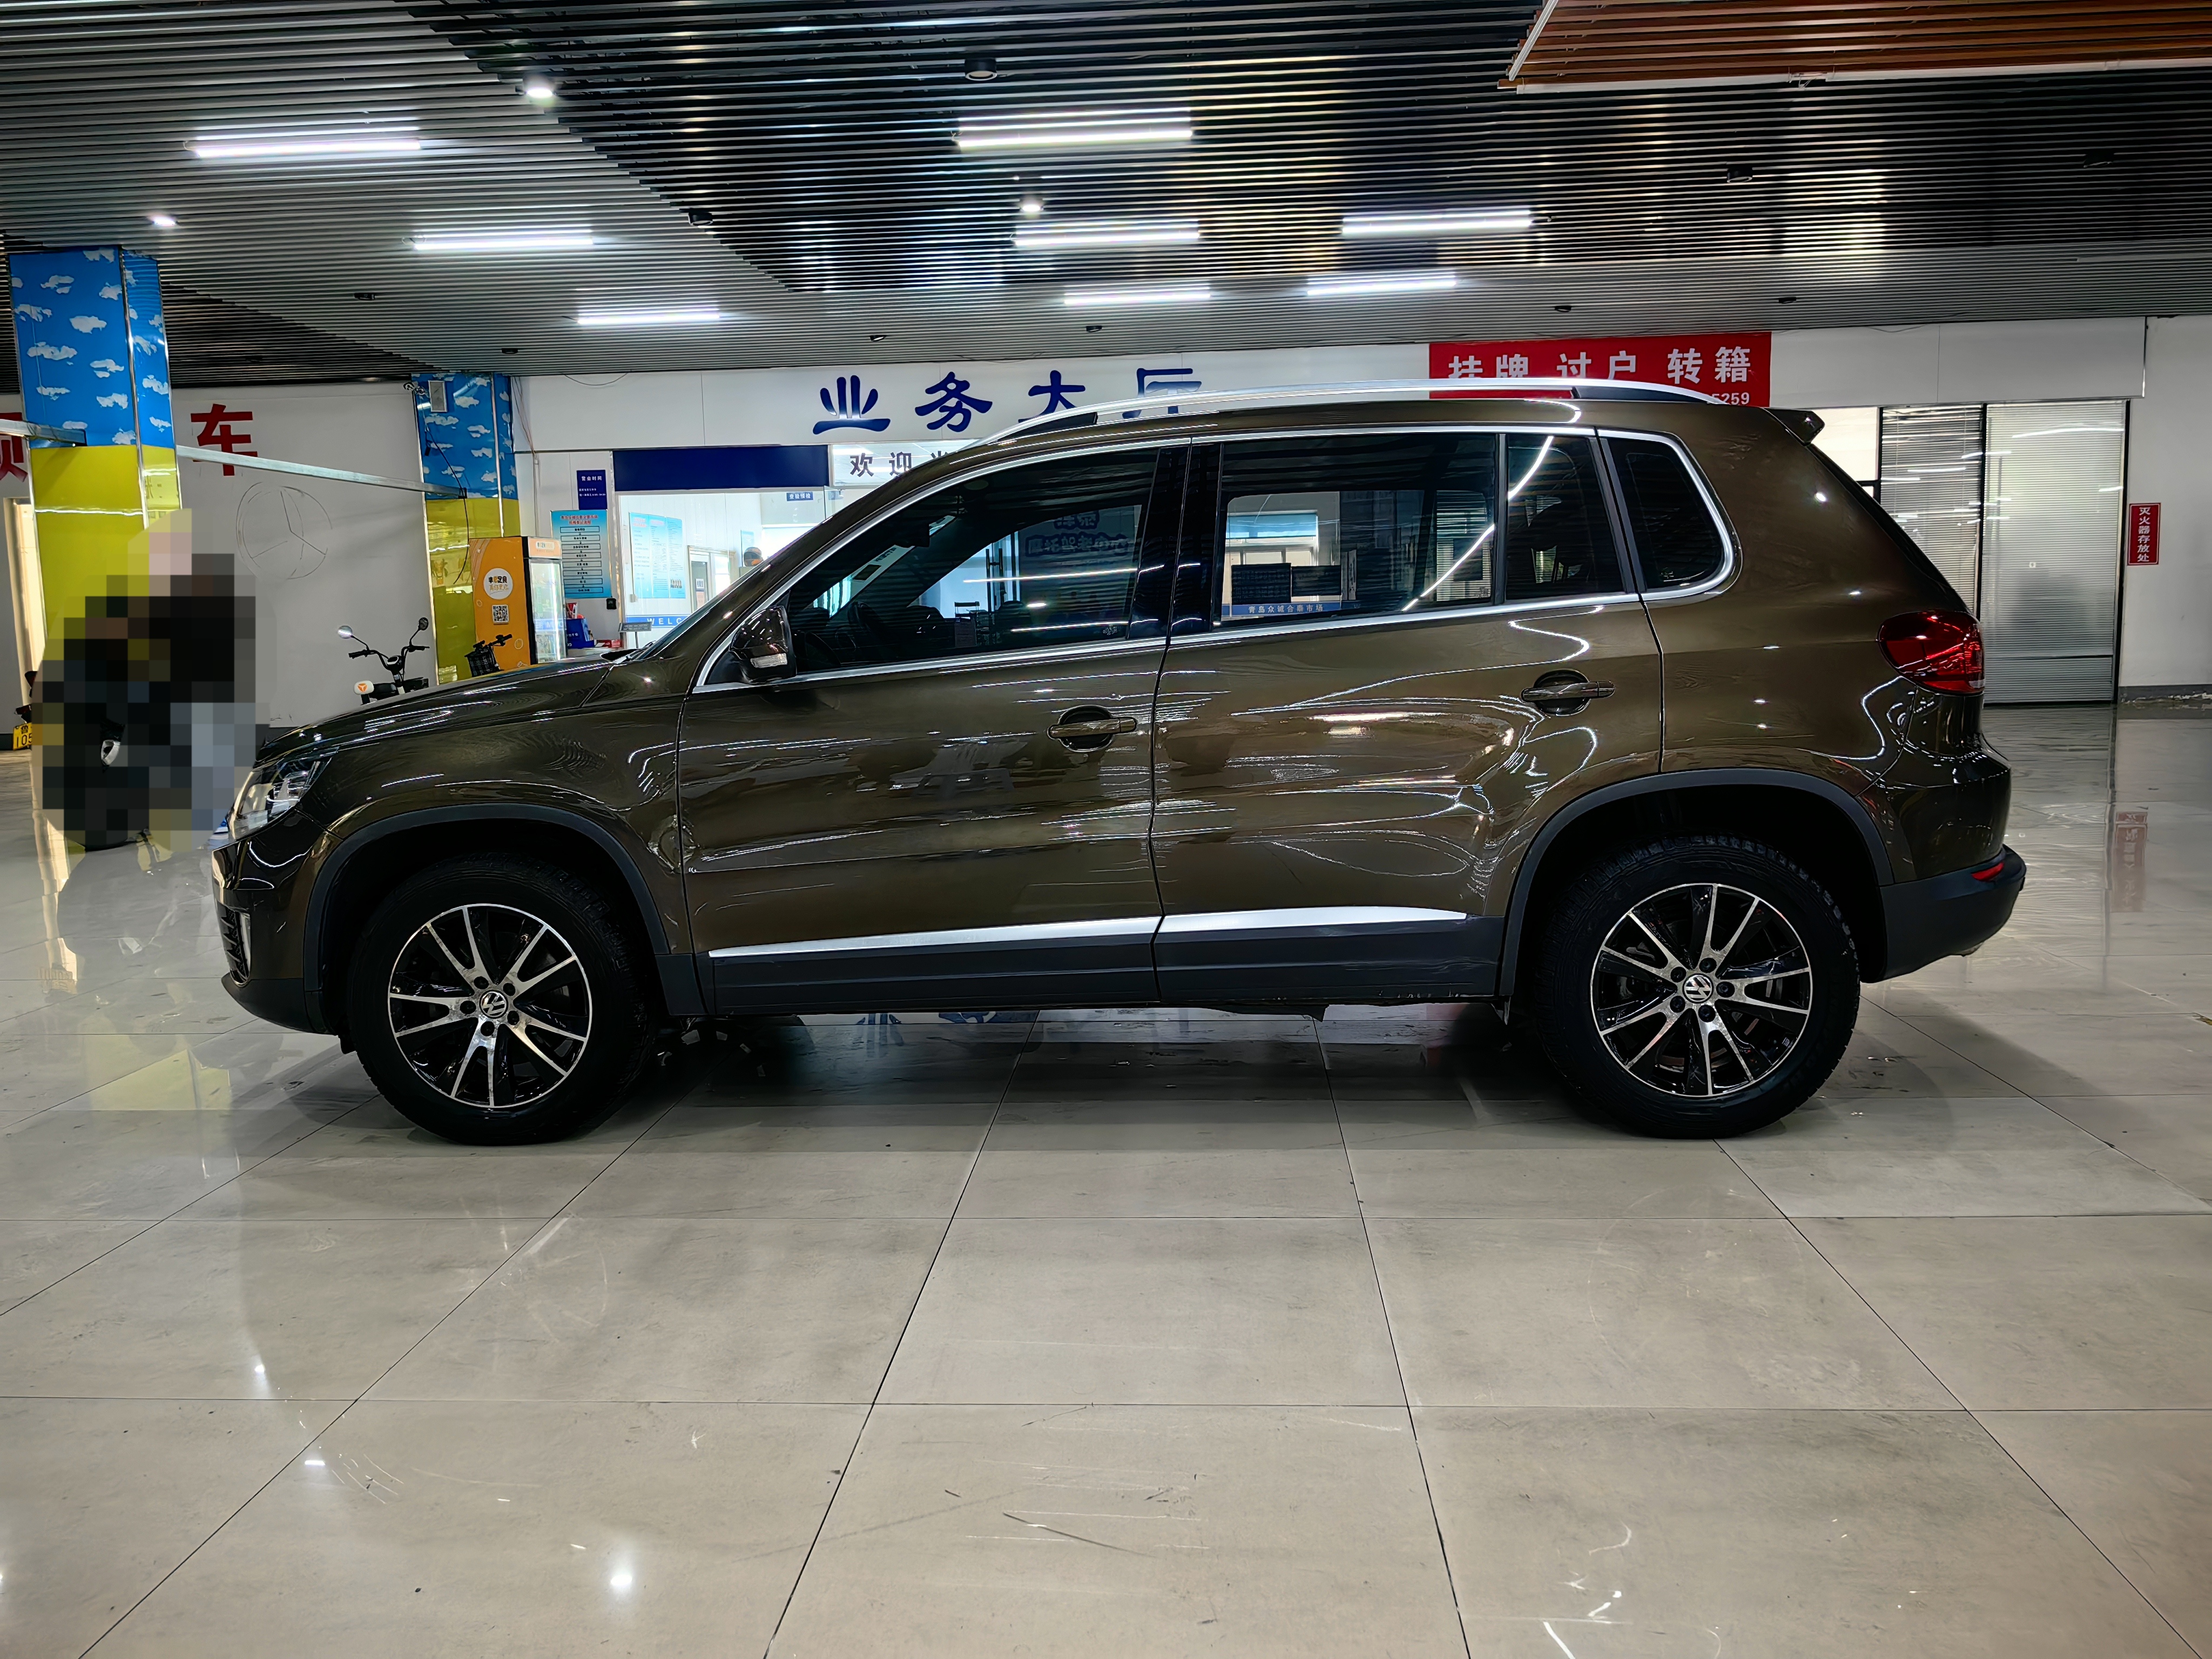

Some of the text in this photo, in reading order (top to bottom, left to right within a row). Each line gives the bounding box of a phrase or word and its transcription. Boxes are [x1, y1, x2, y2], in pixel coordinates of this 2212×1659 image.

[1448, 346, 1751, 384] 挂牌 过户 转籍
[812, 368, 1202, 433] 业务大厅
[191, 403, 258, 476] 车
[2137, 507, 2151, 562] 灭火器存放处
